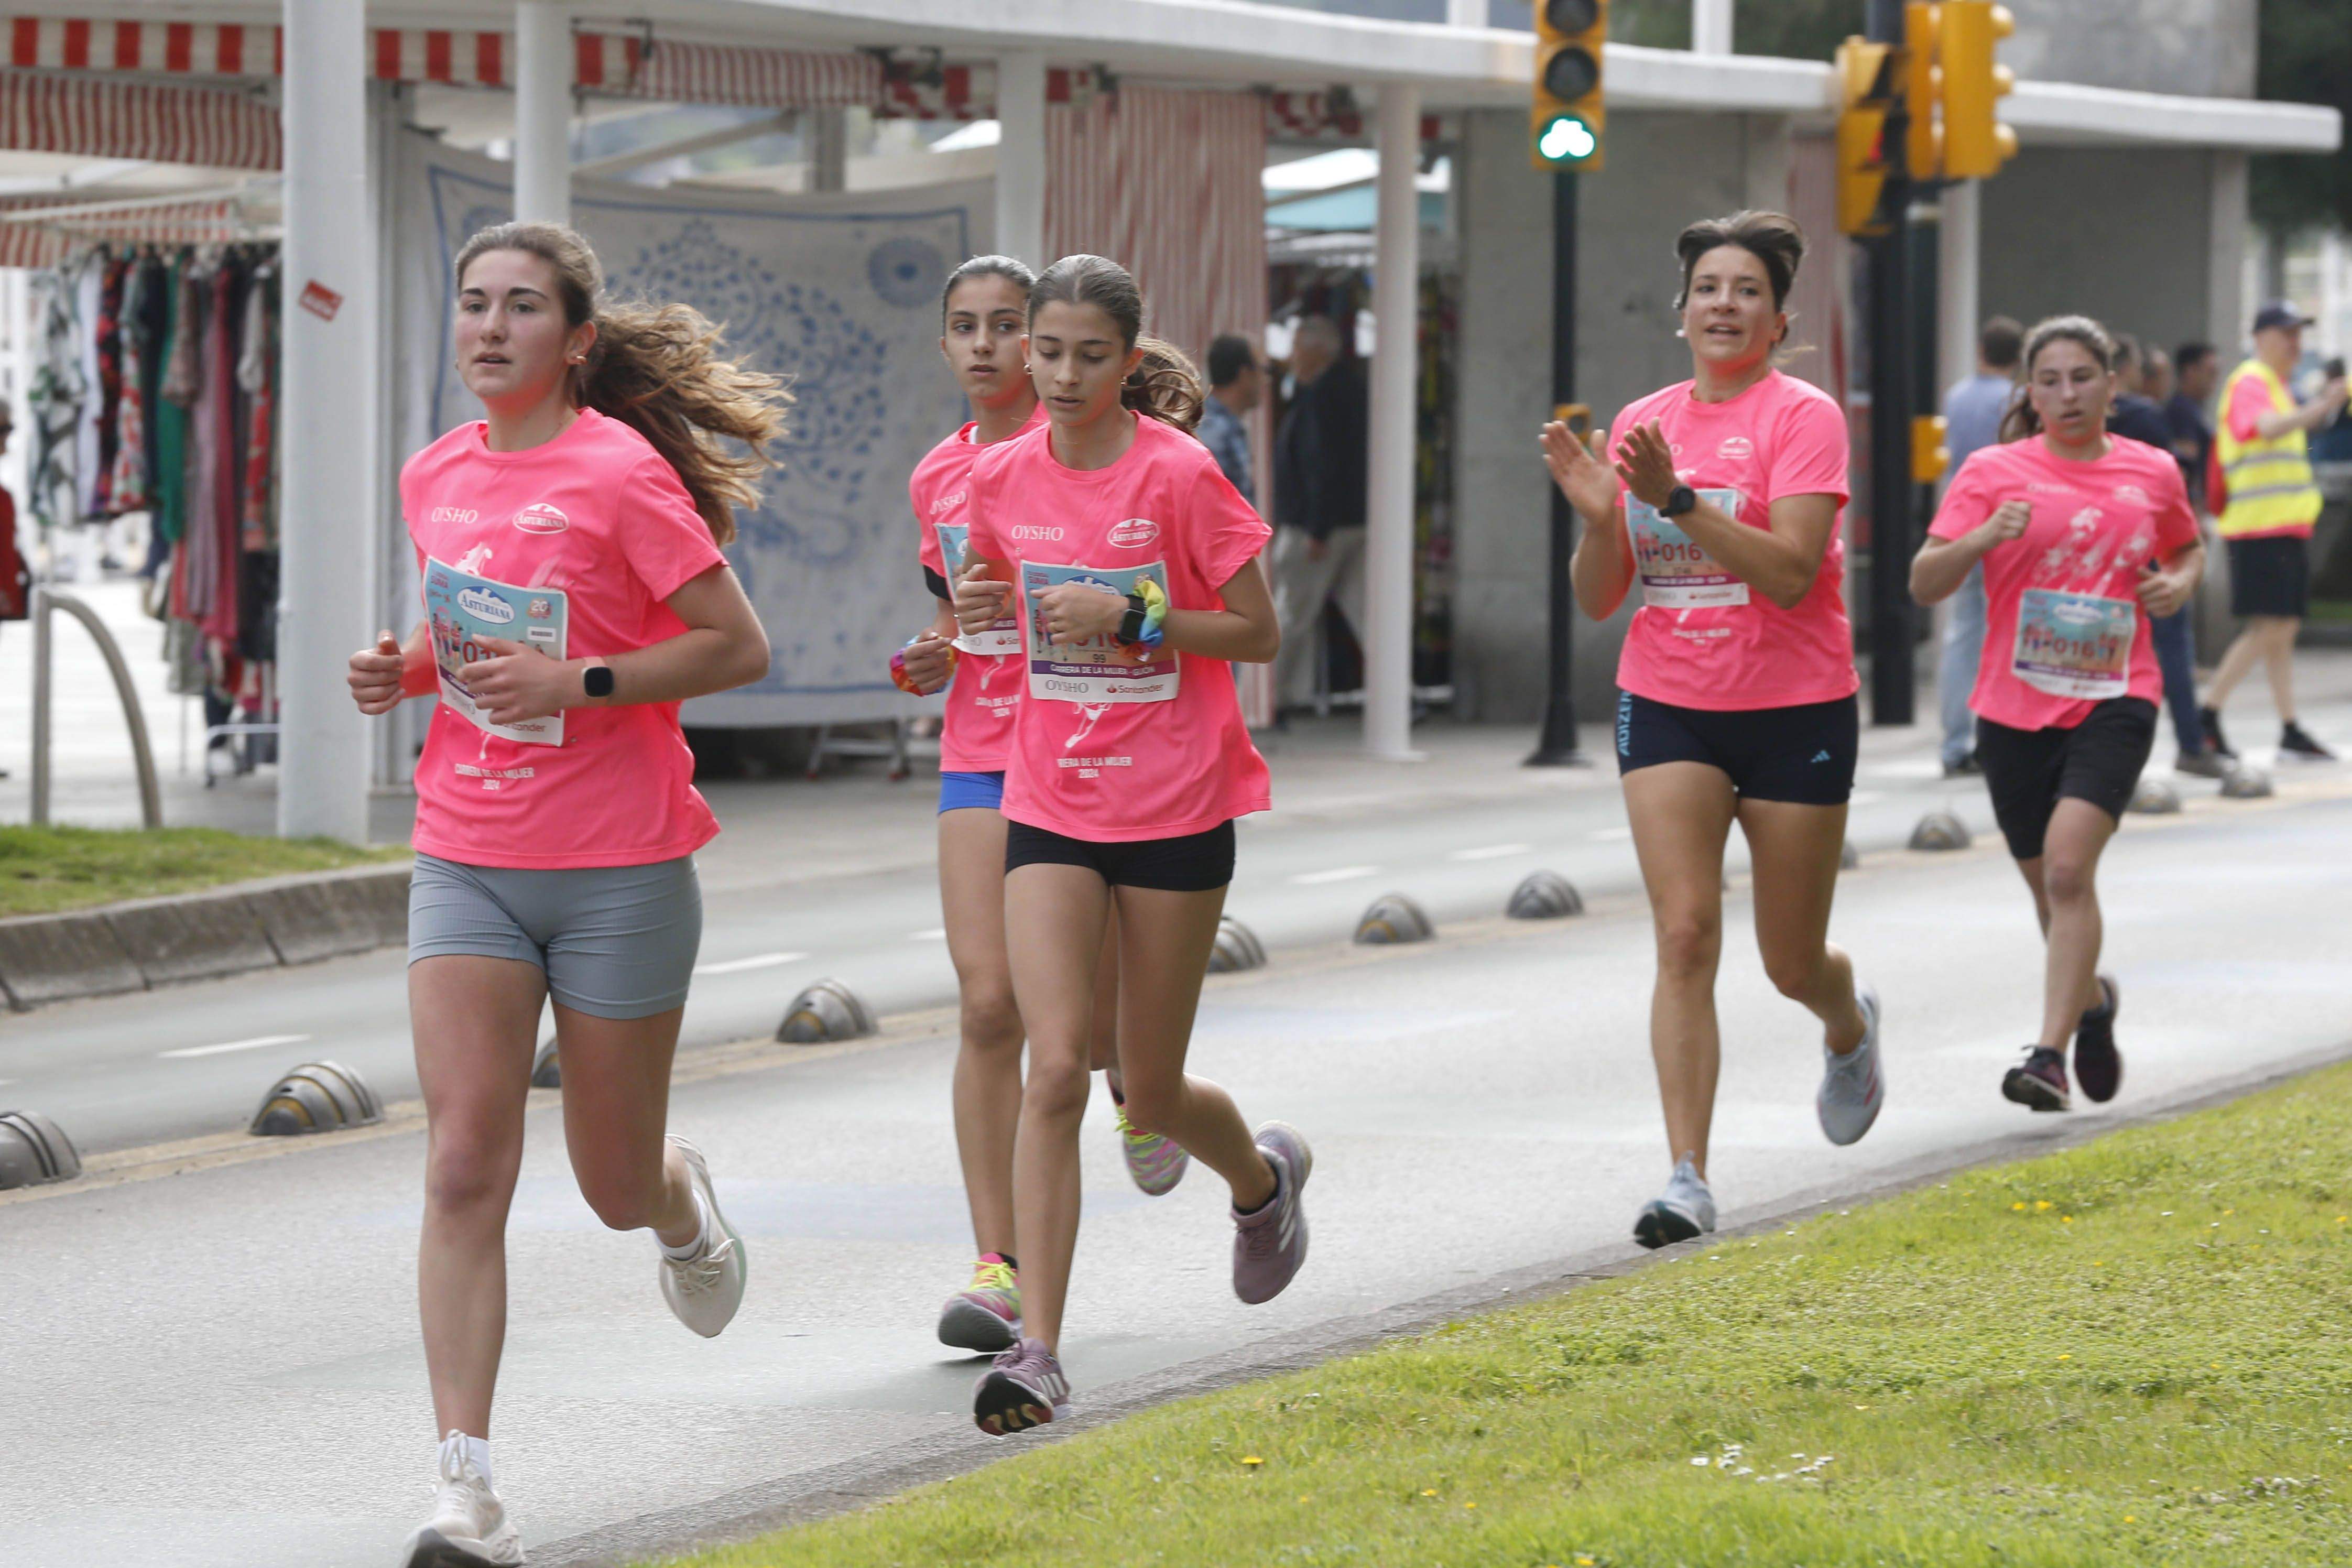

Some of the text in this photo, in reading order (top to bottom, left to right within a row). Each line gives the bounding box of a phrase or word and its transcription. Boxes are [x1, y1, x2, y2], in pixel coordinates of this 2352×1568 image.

[1011, 525, 1064, 541] OYSHO
[1662, 542, 1702, 561] 016
[461, 593, 511, 620] ASTURIANA
[1093, 654, 1106, 663] 99
[1045, 680, 1164, 694] OYSHO Santander
